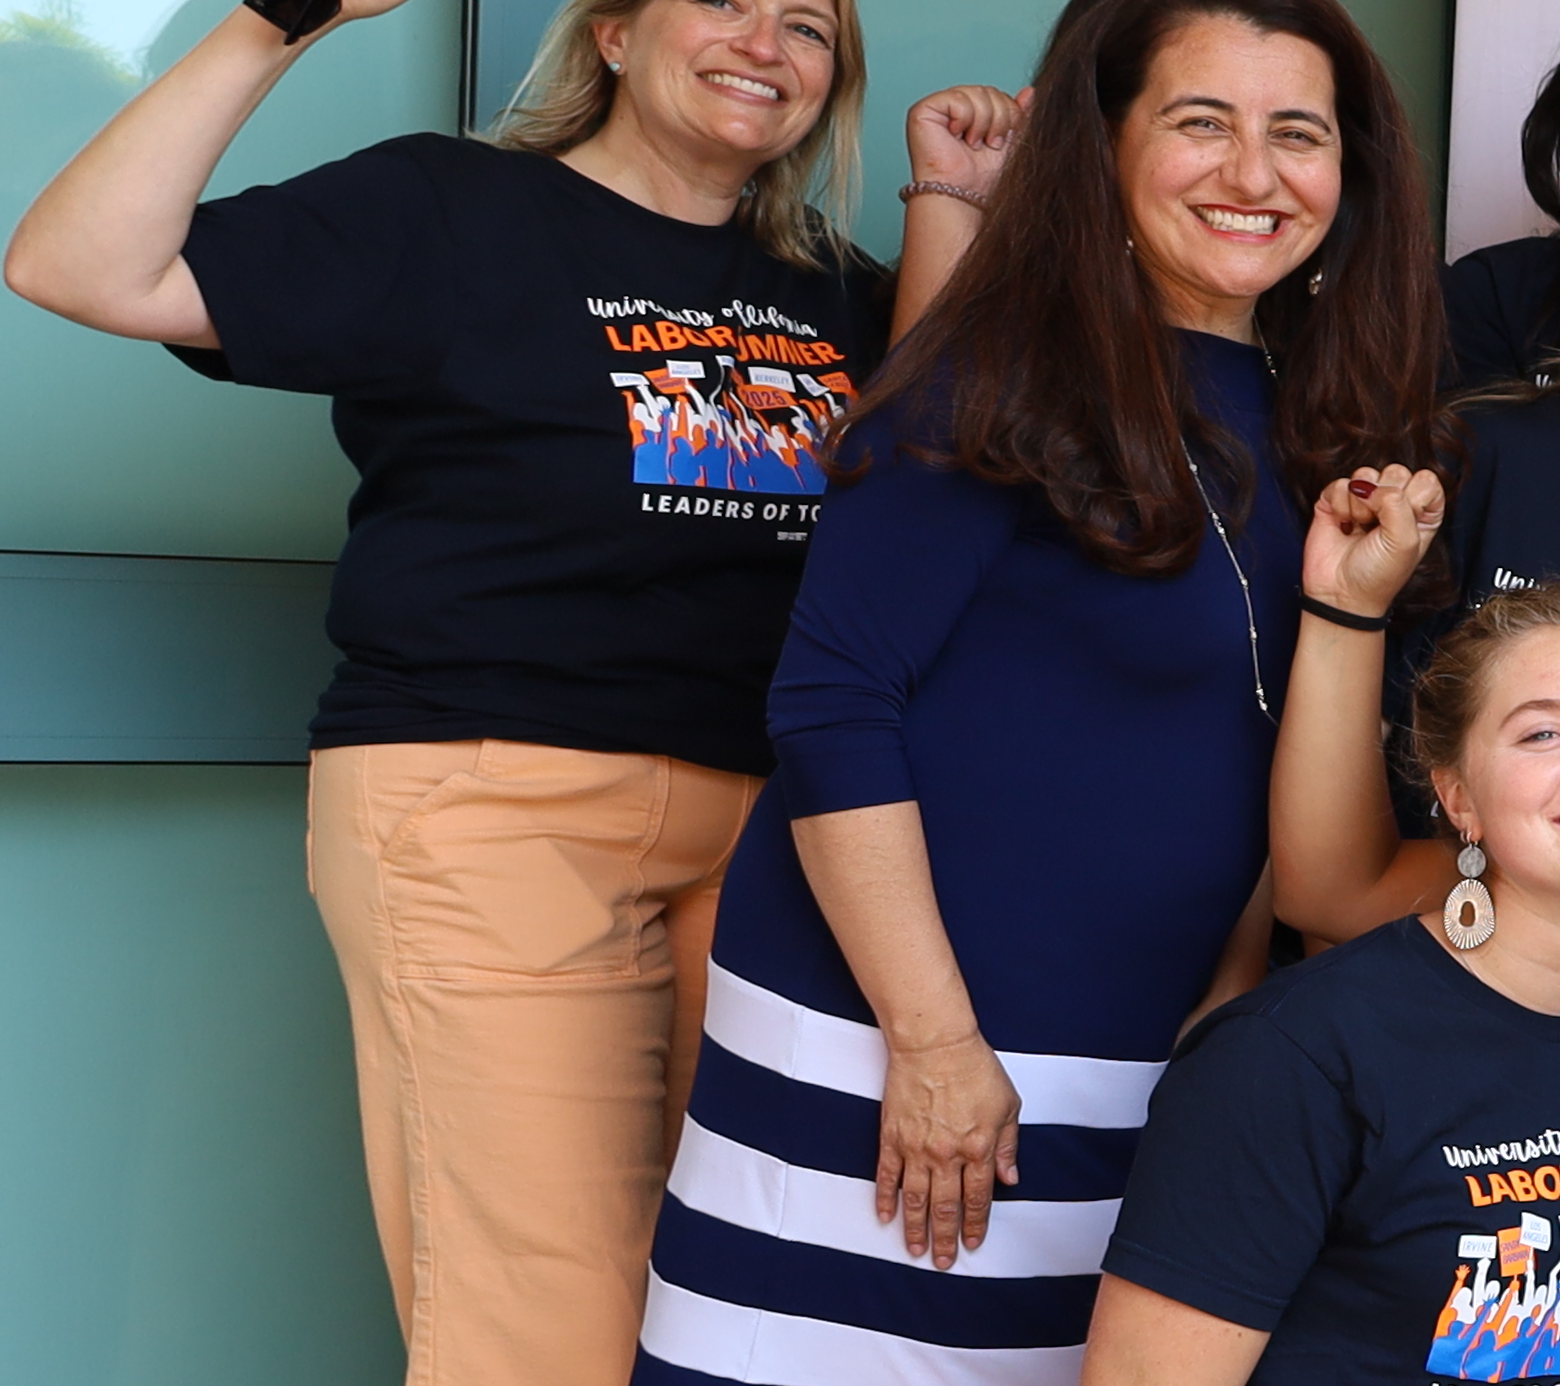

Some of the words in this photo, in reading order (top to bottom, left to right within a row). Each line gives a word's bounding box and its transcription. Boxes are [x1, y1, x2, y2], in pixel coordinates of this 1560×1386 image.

[605, 321, 738, 353] LABOR
[743, 389, 787, 408] 2025
[641, 492, 754, 521] LEADERS
[763, 503, 790, 522] OF
[1462, 1240, 1493, 1252] IRVINE
